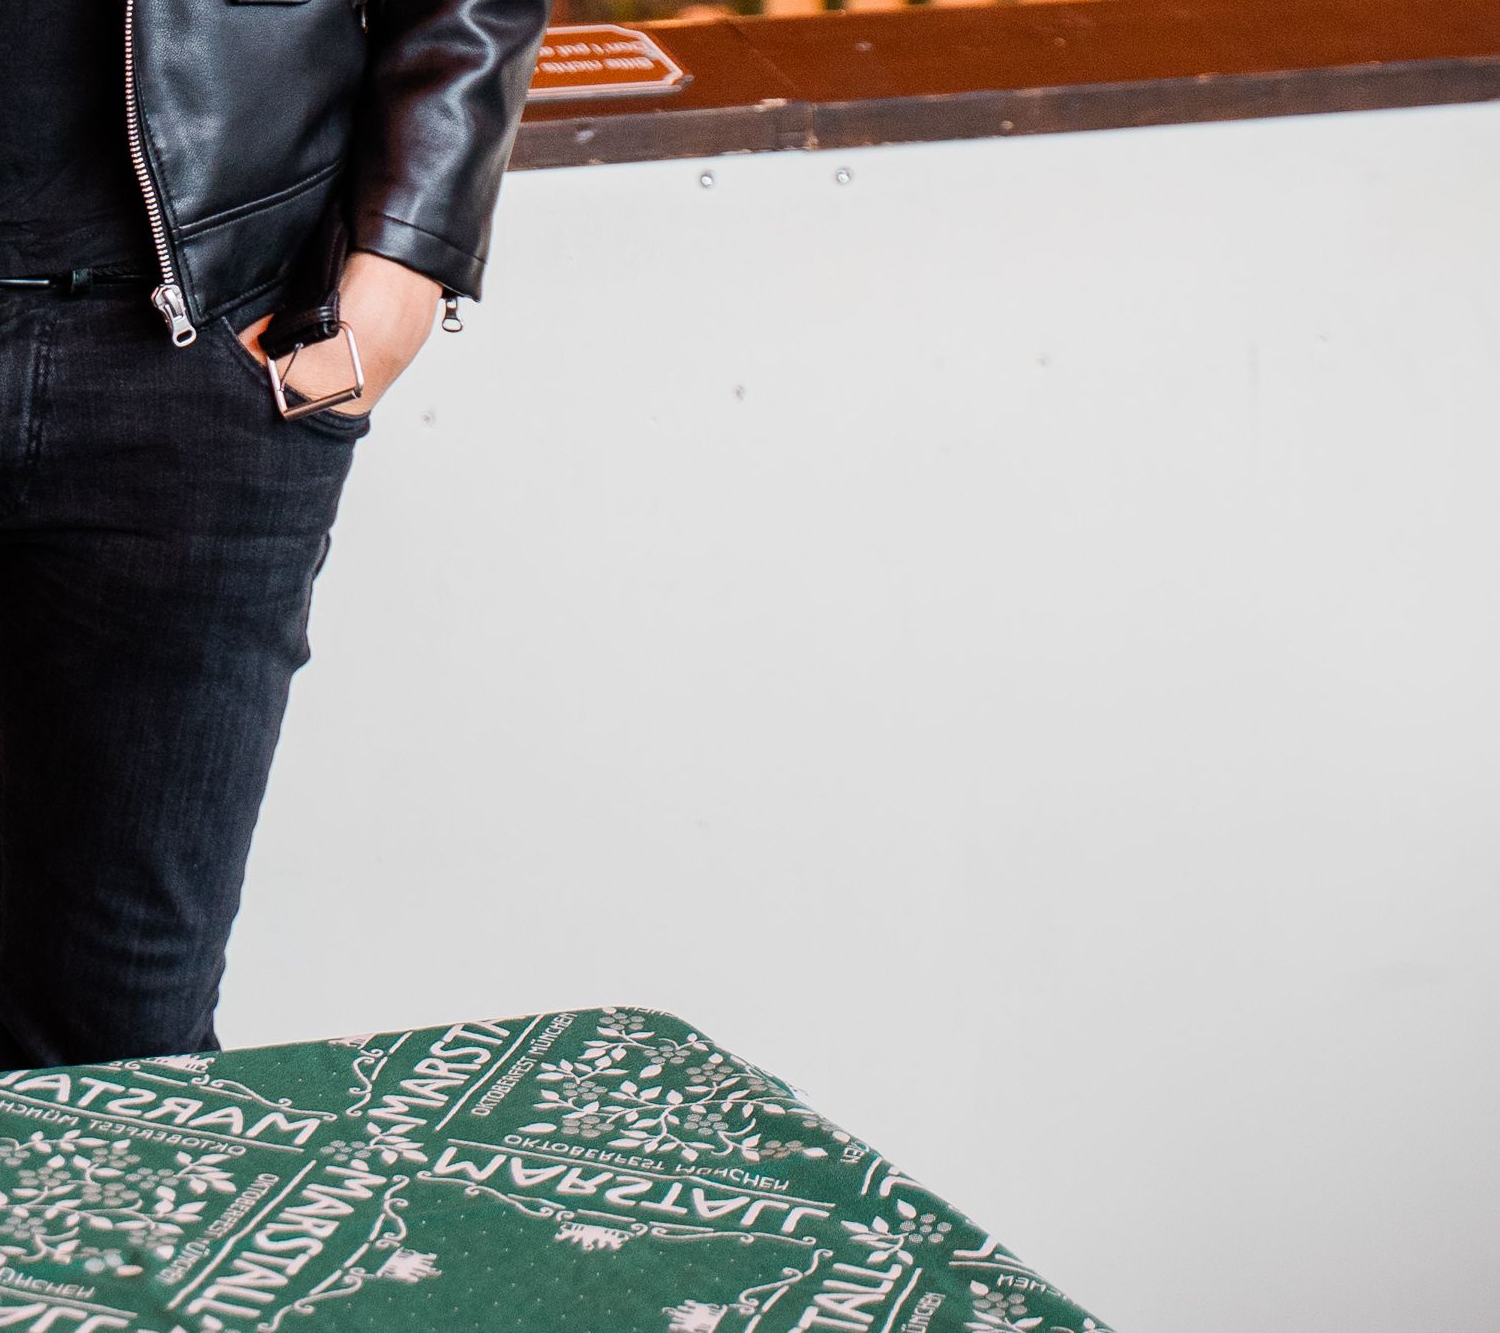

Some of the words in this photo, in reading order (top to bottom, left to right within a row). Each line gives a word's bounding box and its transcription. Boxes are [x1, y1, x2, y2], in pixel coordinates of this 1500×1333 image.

[368, 1017, 511, 1126] MARSTA
[471, 1056, 537, 1117] OKTOBERFEST
[528, 1013, 578, 1055] MÜNCHEN
[186, 1166, 388, 1318] MARSTALL
